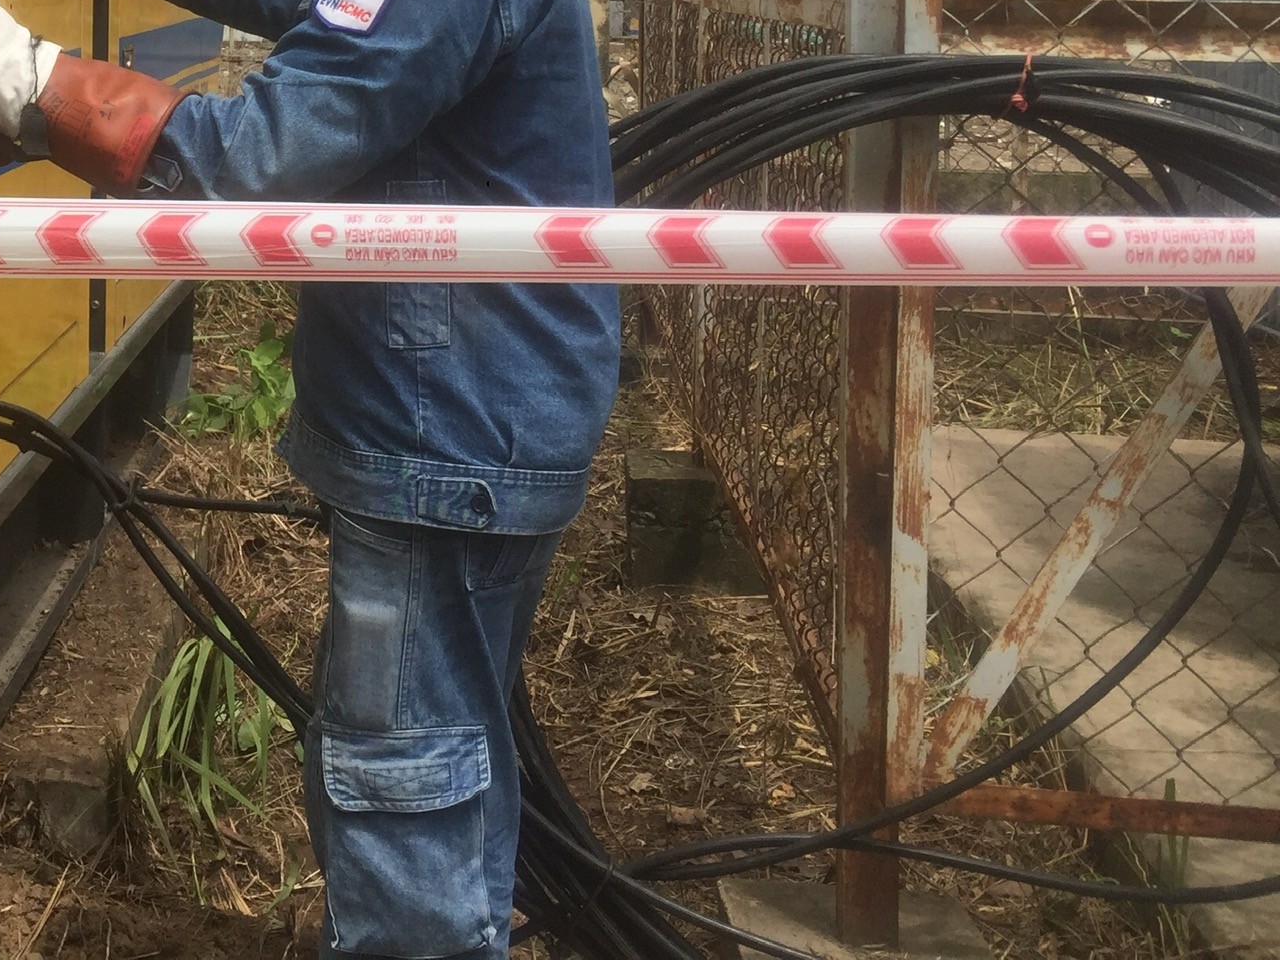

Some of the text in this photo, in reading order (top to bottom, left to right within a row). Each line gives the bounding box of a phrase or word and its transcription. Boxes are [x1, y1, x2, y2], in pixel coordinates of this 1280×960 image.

[345, 229, 458, 243] NOT ALLOWED AREA
[1124, 229, 1256, 243] NOT ALLOWED AREA
[432, 248, 458, 261] KHU
[1227, 249, 1256, 262] KHU
